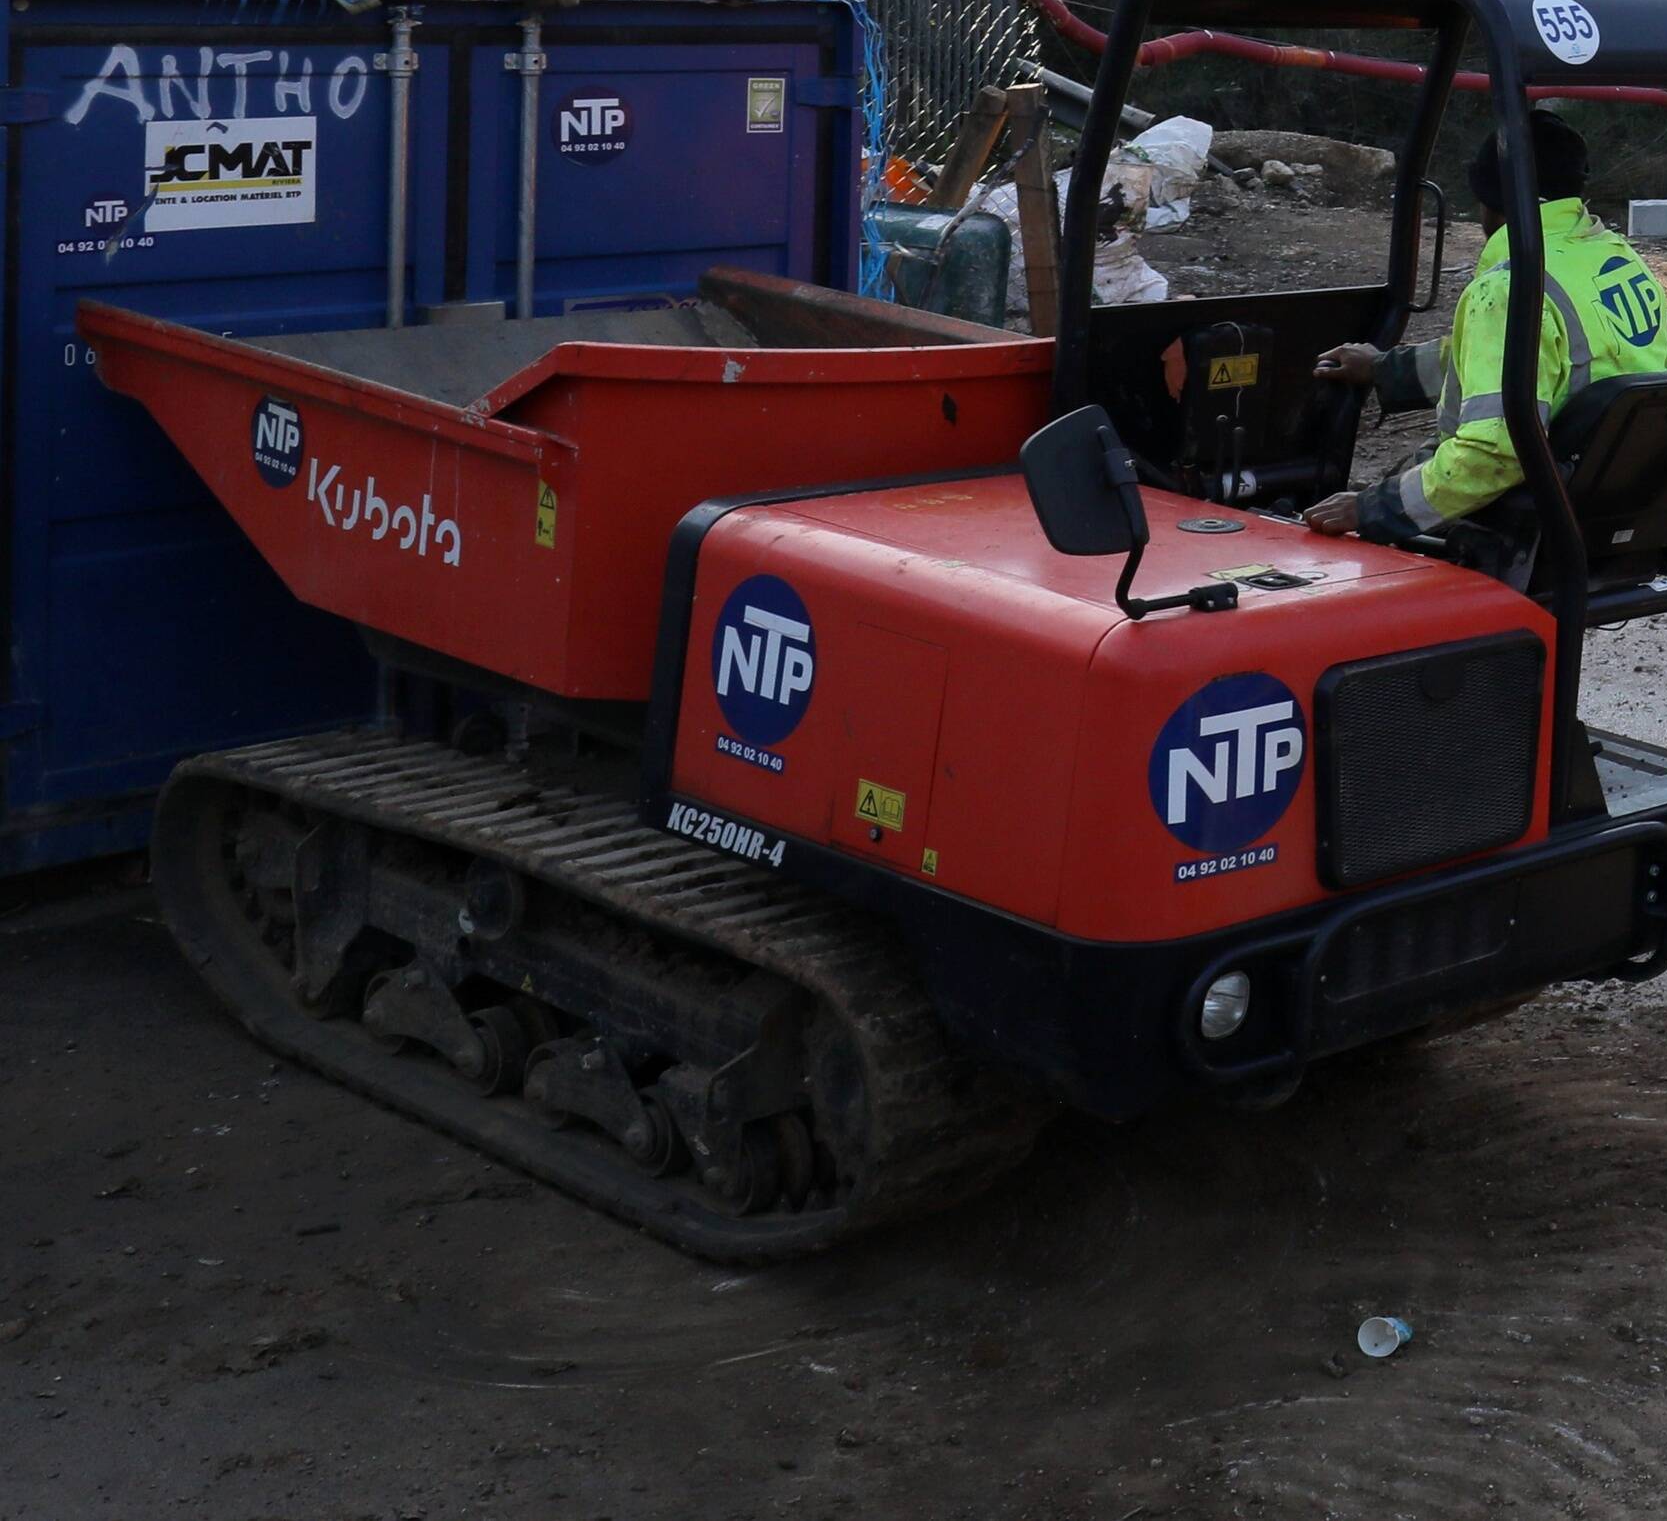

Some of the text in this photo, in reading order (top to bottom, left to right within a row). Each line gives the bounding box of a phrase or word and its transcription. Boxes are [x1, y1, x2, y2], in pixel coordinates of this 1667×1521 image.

[1536, 5, 1593, 43] 555
[65, 44, 368, 124] ANTHO
[560, 98, 625, 142] NTP
[561, 143, 573, 152] 04
[574, 143, 586, 152] 92
[588, 143, 599, 151] 02
[613, 142, 625, 150] 40
[85, 200, 128, 227] NTP
[191, 194, 237, 203] LOCATION
[240, 191, 283, 201] MATÉRIEL
[285, 190, 302, 199] BTP
[57, 243, 74, 253] 04
[78, 241, 94, 252] 92
[137, 237, 154, 247] 40
[1591, 260, 1661, 338] NTP
[256, 403, 300, 454] NTP
[307, 457, 462, 567] Kubota
[717, 605, 813, 705] NTP
[717, 736, 782, 771] 04 92 02 10 40
[1167, 700, 1303, 825] NTP
[666, 802, 787, 868] KC250HR-4
[1178, 847, 1275, 879] 04 92 02 10 40
